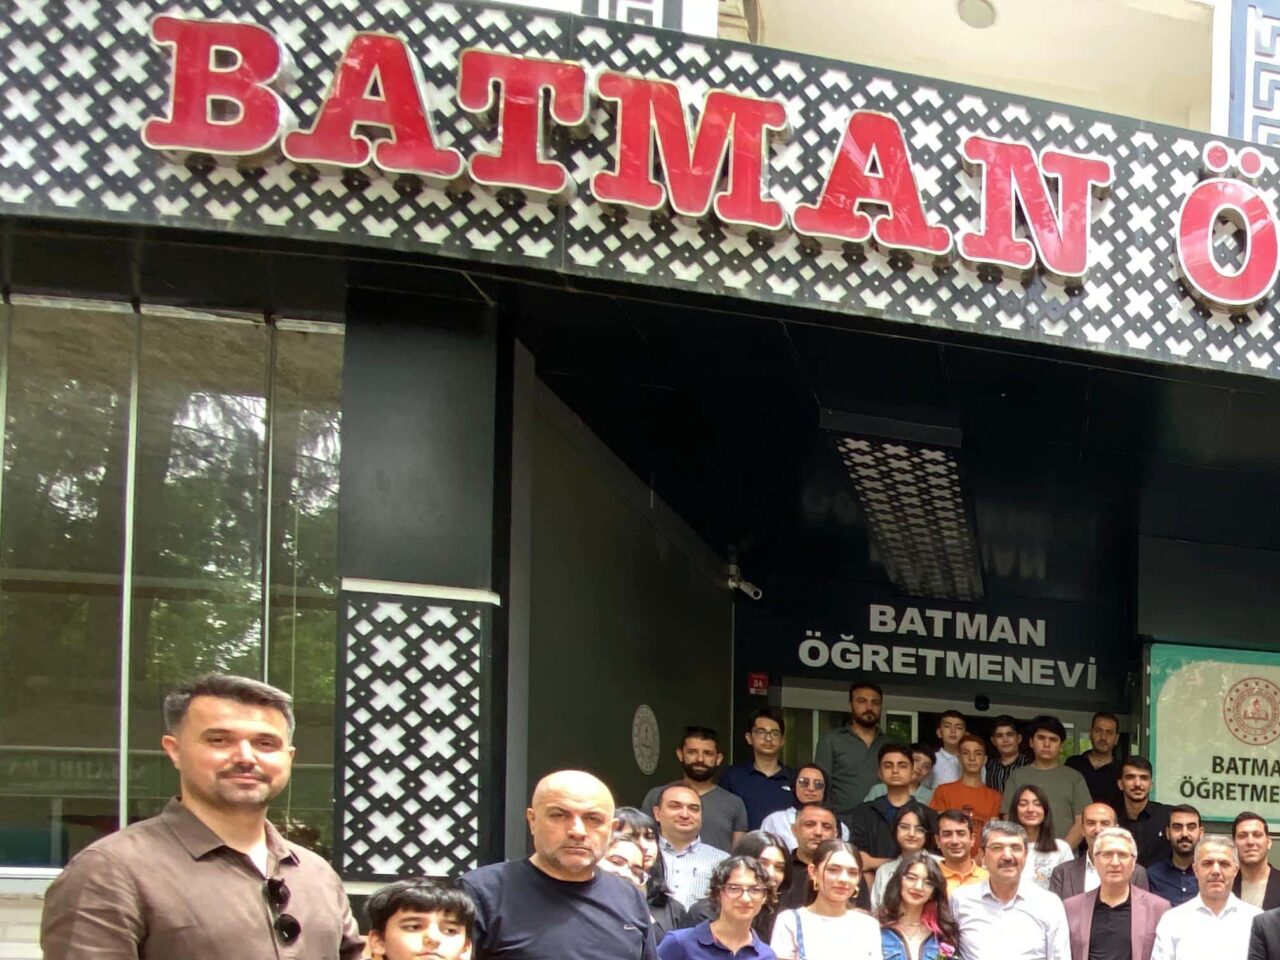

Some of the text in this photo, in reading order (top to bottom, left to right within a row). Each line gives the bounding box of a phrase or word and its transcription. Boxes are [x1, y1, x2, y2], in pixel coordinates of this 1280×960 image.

[142, 16, 1112, 277] BATMAN
[869, 603, 1046, 647] BATMAN
[798, 630, 1097, 690] ÖĞRETMENEVİ
